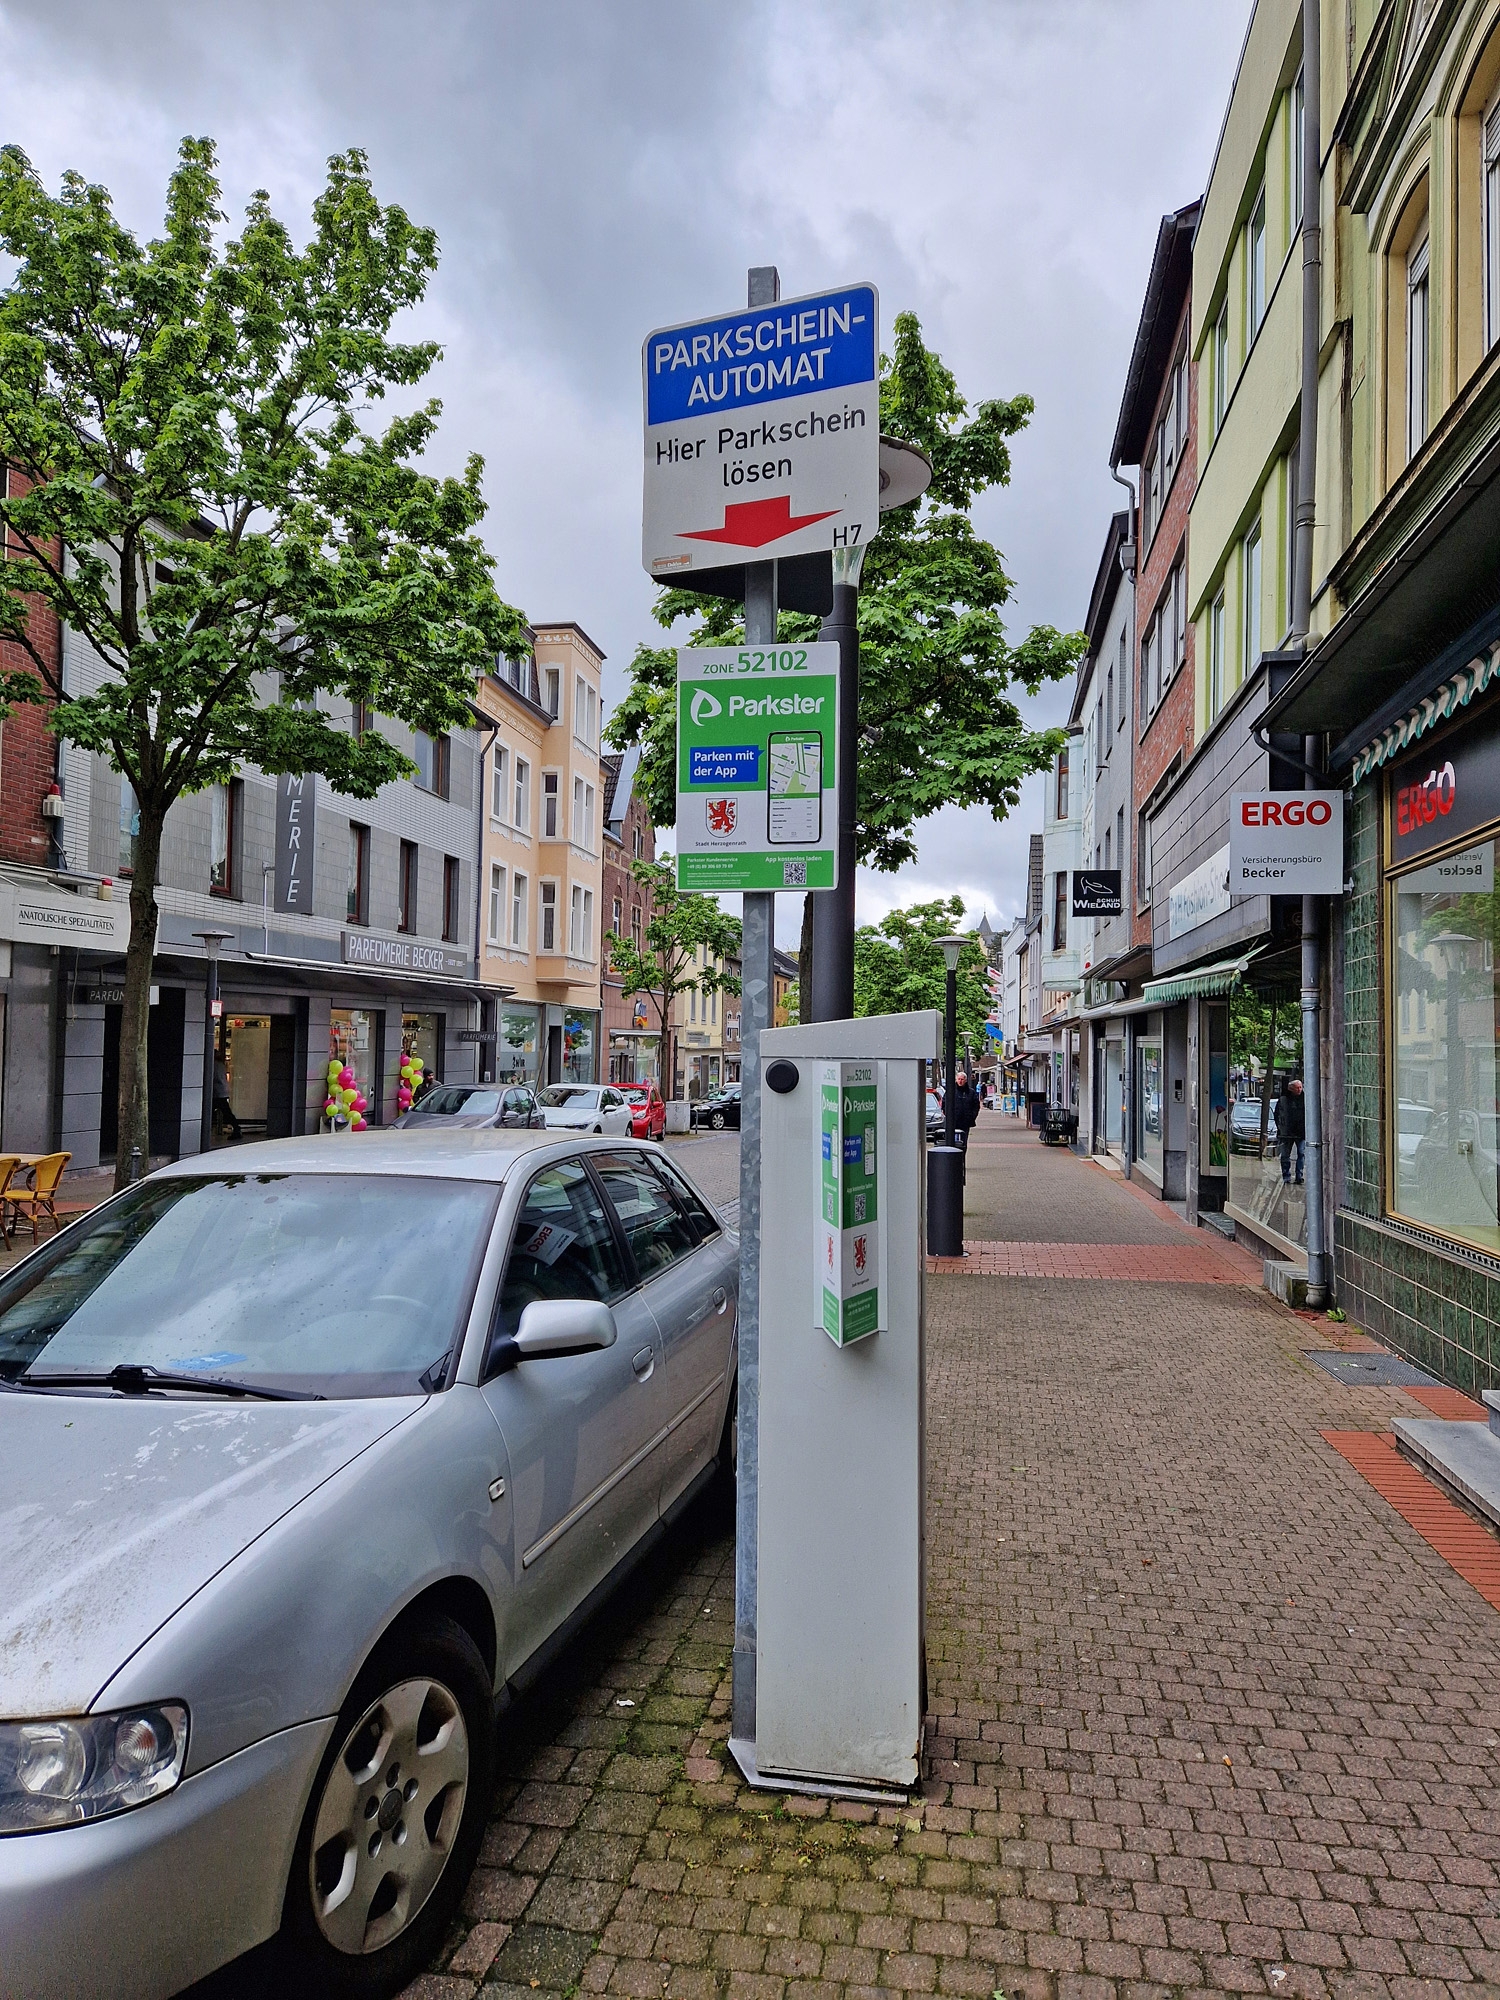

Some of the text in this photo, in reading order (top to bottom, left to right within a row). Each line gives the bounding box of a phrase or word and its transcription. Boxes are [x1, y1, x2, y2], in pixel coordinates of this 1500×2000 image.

[655, 302, 866, 374] PARKSCHEIN-
[687, 347, 831, 407] AUTOMAT
[656, 404, 866, 465] Hier Parkschein
[723, 458, 792, 487] lösen
[833, 523, 862, 547] H7
[703, 650, 808, 674] ZONE 52102
[728, 693, 825, 717] Parkster
[694, 750, 755, 762] Parken mit
[693, 765, 737, 777] der App
[1397, 761, 1456, 836] ERGO
[1241, 800, 1332, 826] ERGO
[1241, 856, 1322, 865] Versicherungsbüro
[1241, 867, 1286, 878] Becker
[1073, 900, 1120, 908] WIELAND
[19, 910, 115, 931] ANATOLISCHE SPEZIALITÄTEN
[350, 936, 410, 967] PARFÜMERIE
[412, 947, 444, 970] BECKER
[855, 1069, 872, 1081] 52102
[853, 1099, 876, 1112] Parkster
